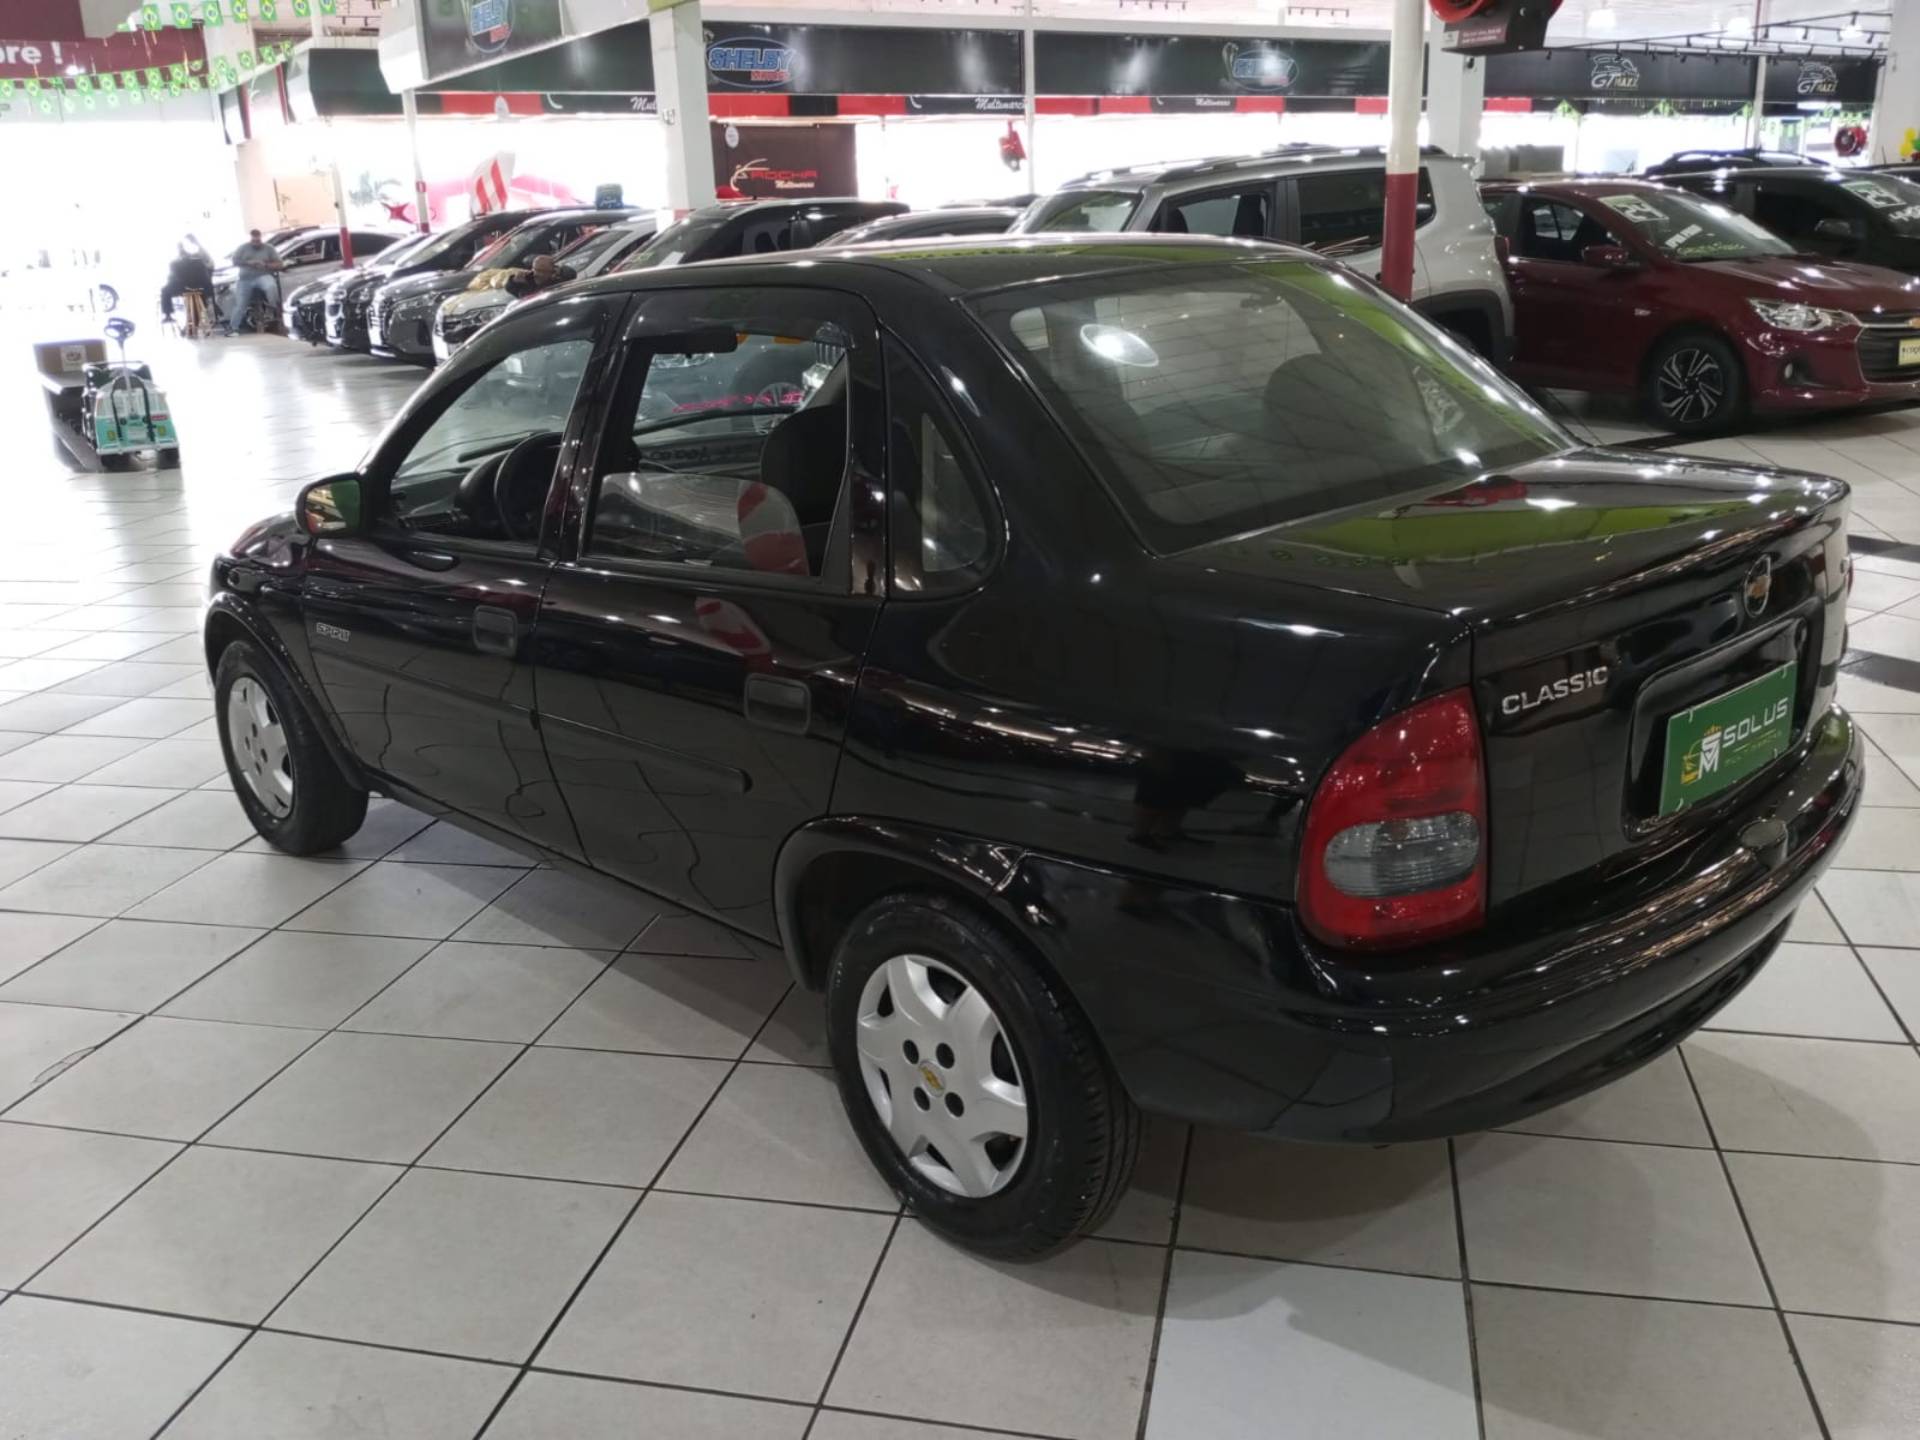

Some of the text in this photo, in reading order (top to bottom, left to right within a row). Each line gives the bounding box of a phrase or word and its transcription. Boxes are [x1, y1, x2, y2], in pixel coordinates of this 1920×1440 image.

[708, 47, 797, 71] SHELBY
[1502, 665, 1608, 715] CLASSIC
[1722, 697, 1789, 748] SOLUS
